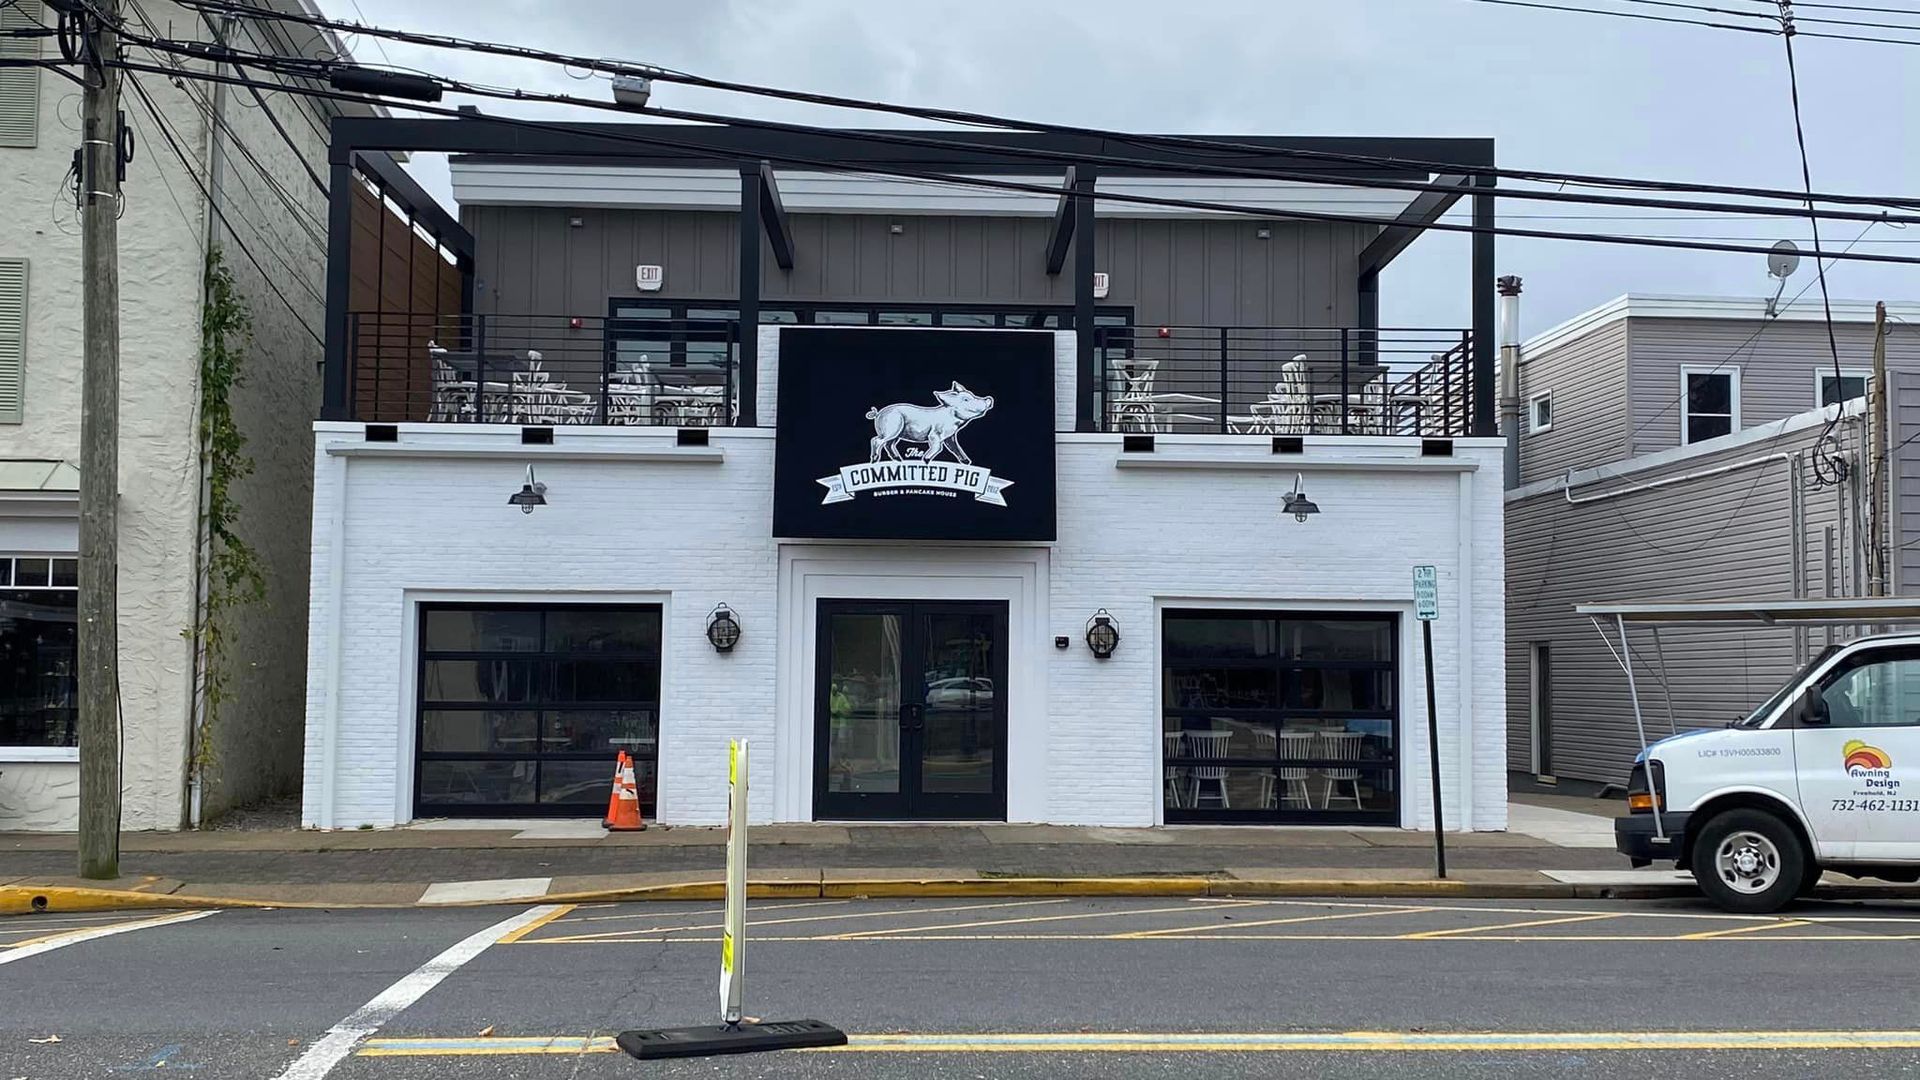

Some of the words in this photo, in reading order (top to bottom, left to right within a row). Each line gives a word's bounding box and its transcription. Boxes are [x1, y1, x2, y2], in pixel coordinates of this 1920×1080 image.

[641, 267, 658, 280] EXIT
[1094, 275, 1105, 287] XIT
[904, 447, 925, 458] The
[850, 465, 948, 486] COMMITTED
[953, 468, 980, 487] PIG
[935, 490, 957, 498] HOUSE
[1417, 569, 1422, 578] 2
[1698, 750, 1717, 758] LIC#
[1851, 769, 1890, 778] Awning
[1866, 779, 1900, 789] Design
[1831, 799, 1920, 812] 732-462-1131
